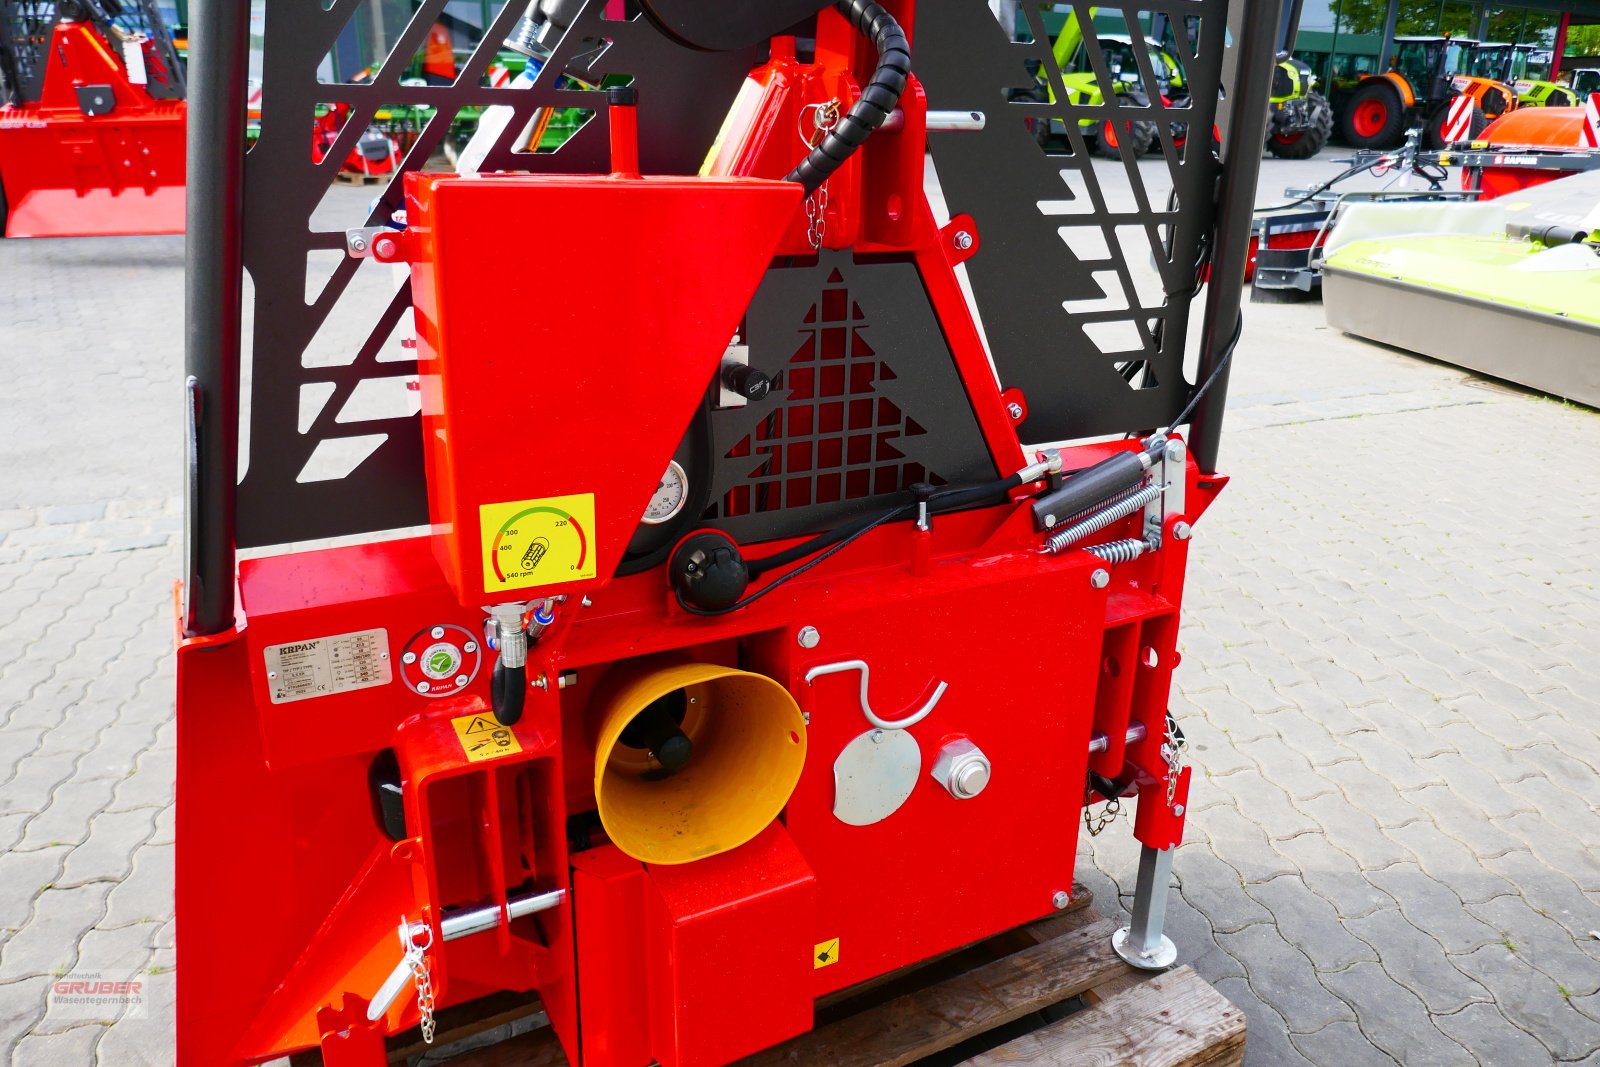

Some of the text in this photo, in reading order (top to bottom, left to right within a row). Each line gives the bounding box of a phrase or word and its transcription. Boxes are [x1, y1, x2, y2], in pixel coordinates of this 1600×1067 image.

[1503, 156, 1538, 165] SAPHIR
[519, 570, 534, 578] rpm
[279, 641, 317, 656] KRPAN
